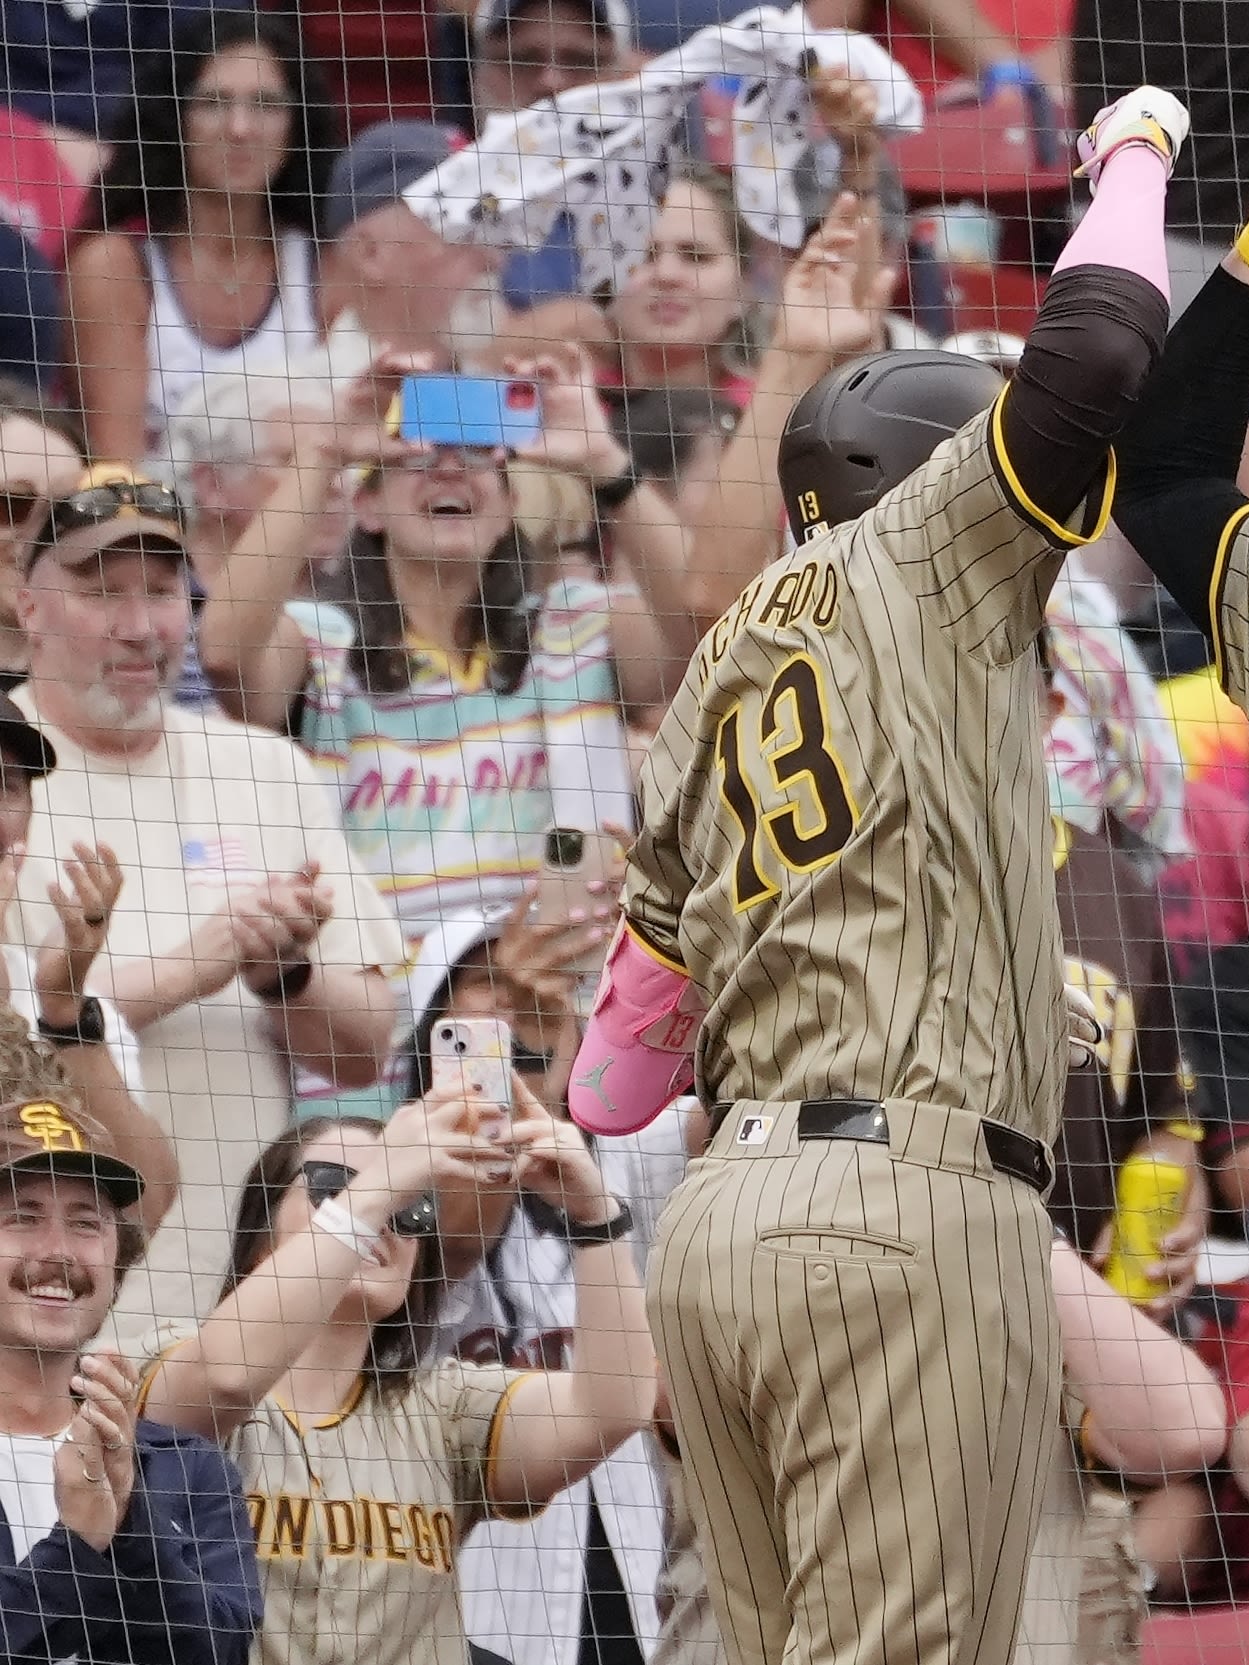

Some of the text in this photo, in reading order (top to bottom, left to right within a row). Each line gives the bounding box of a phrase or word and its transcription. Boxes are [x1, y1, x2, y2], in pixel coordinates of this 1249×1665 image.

[797, 490, 820, 523] 13
[714, 651, 861, 914] 13
[20, 1103, 83, 1152] SD
[320, 1496, 454, 1575] DIEGO
